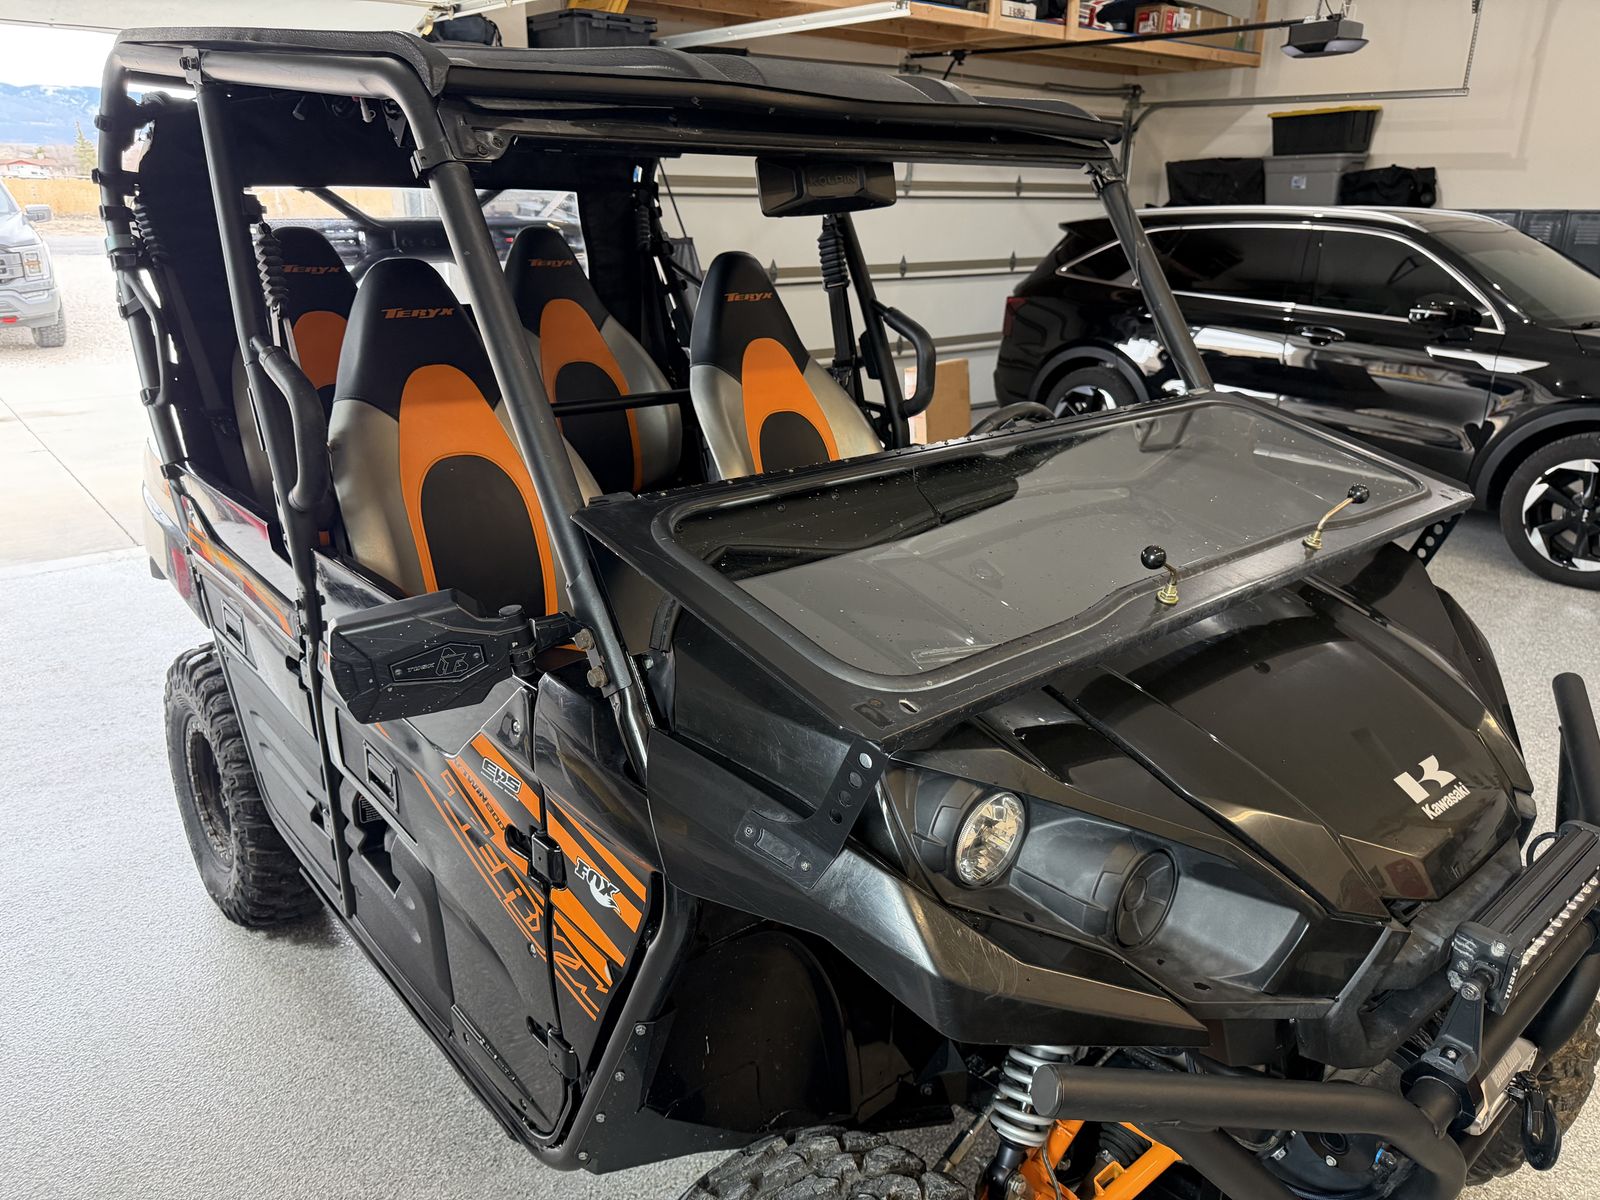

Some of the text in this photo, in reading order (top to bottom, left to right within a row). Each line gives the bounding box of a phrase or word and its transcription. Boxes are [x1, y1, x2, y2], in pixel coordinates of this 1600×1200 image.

[481, 757, 522, 794] EPS
[1421, 781, 1471, 820] Kawasaki
[574, 855, 621, 900] FOX
[1504, 966, 1519, 1000] TUSK
